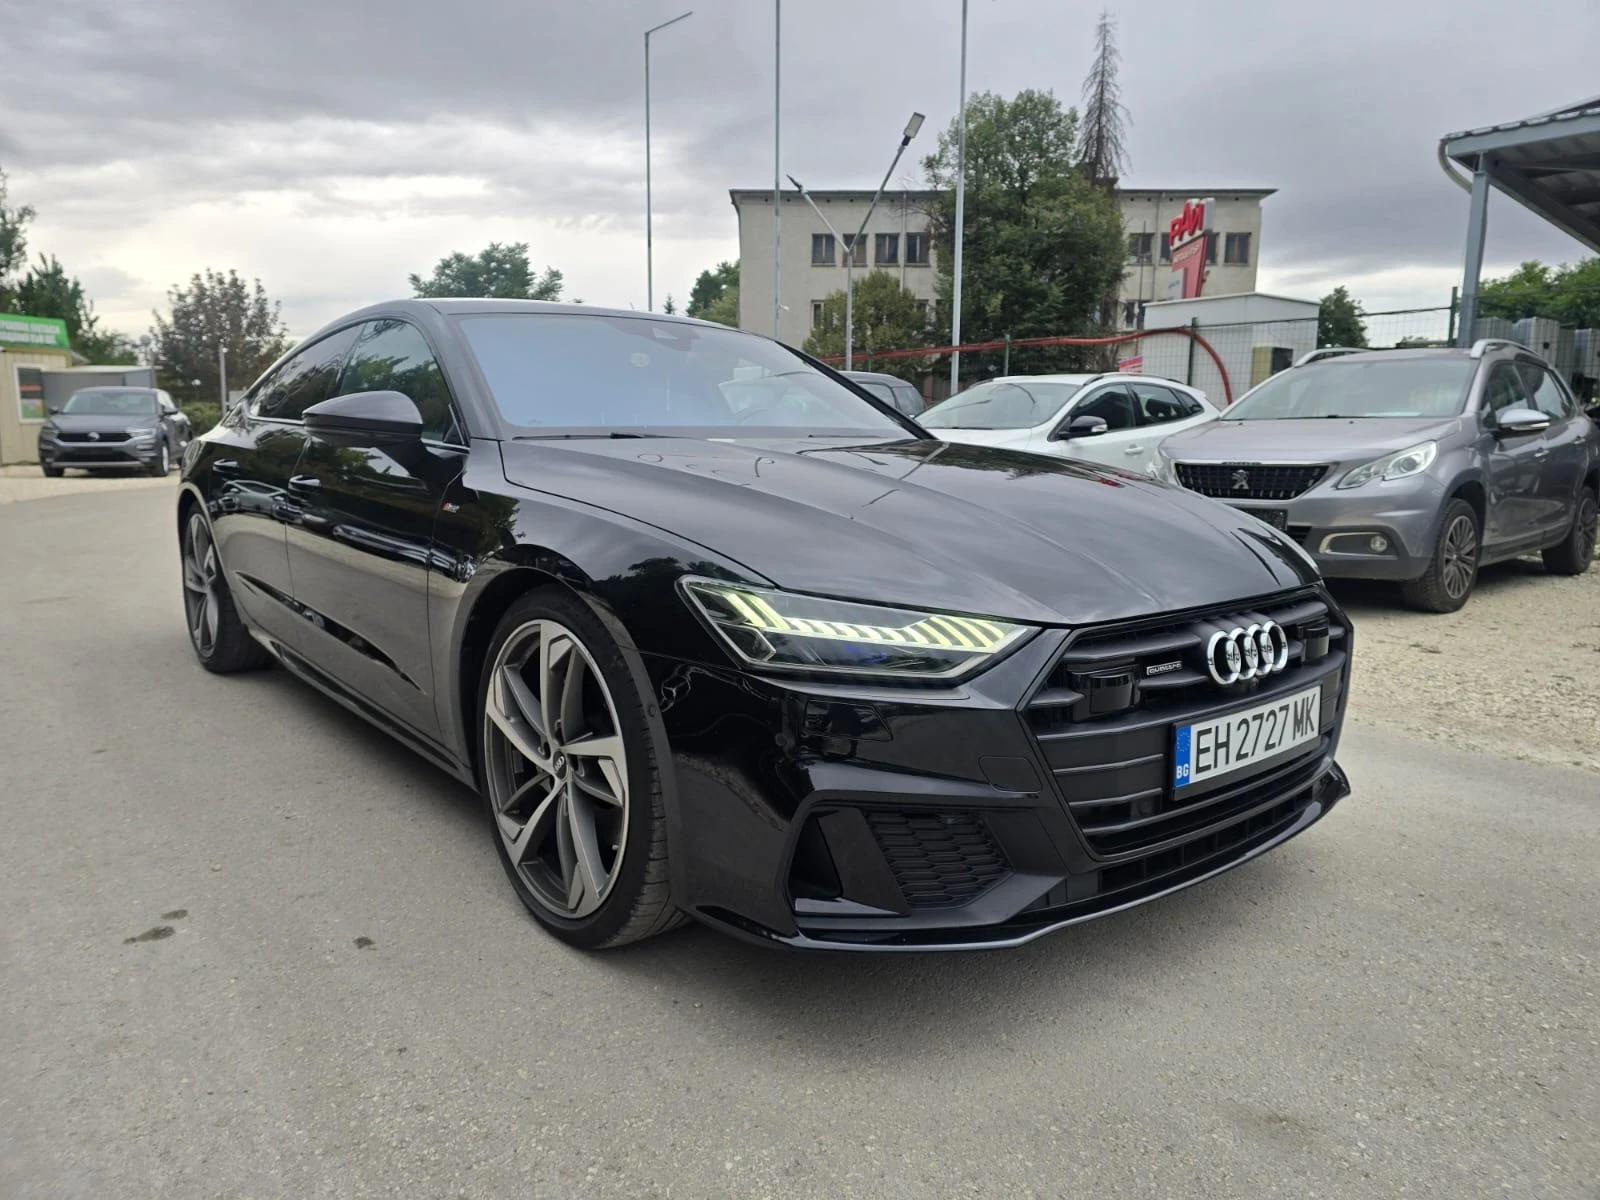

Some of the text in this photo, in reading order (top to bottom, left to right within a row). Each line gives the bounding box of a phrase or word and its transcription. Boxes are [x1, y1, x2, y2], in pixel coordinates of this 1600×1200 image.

[1195, 693, 1316, 775] EH 2727 MK
[1176, 763, 1189, 779] BG
